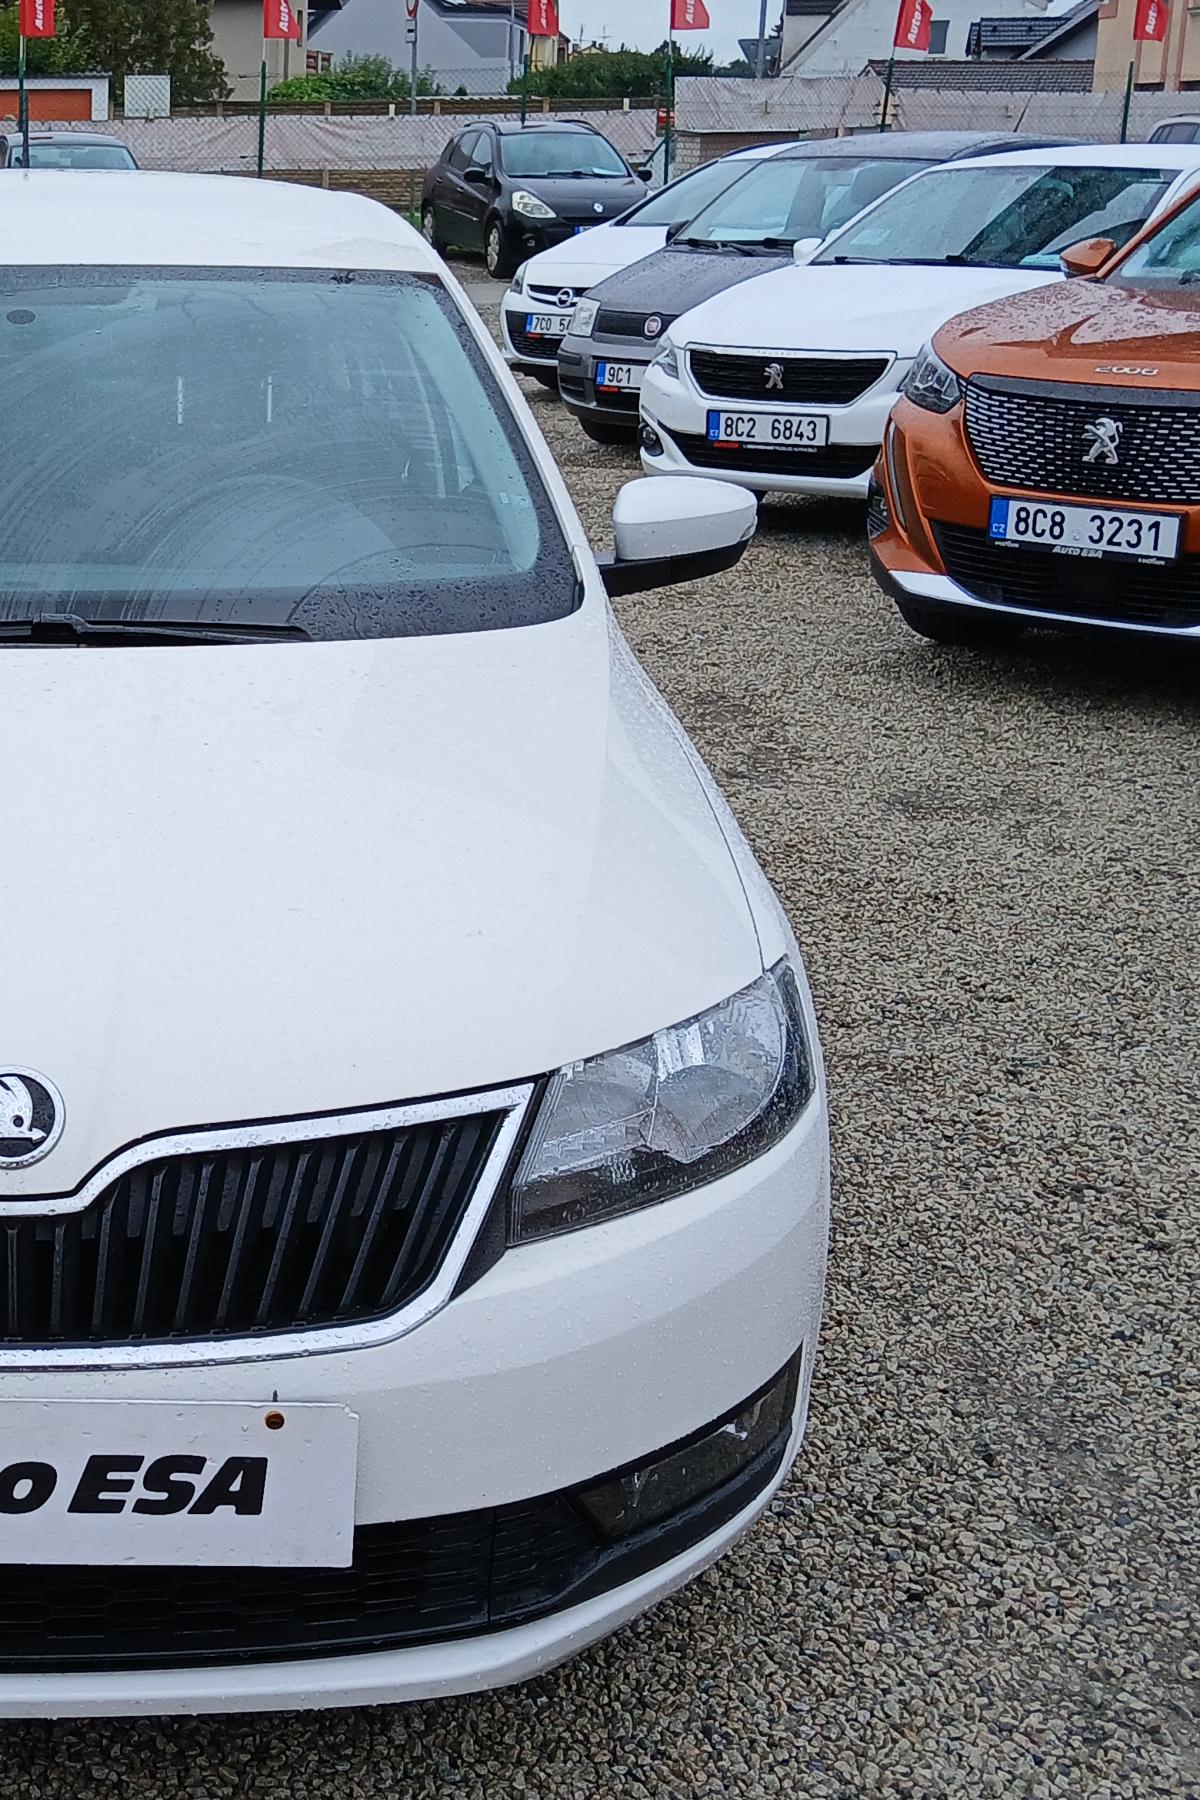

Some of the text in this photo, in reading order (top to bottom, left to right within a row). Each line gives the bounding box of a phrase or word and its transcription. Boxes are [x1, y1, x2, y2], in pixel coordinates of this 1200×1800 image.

[607, 366, 632, 385] 9C1
[724, 416, 757, 438] 8C2
[771, 418, 817, 441] 6843
[992, 506, 1161, 552] CZ 8C8 3231
[67, 1454, 269, 1516] ESA
